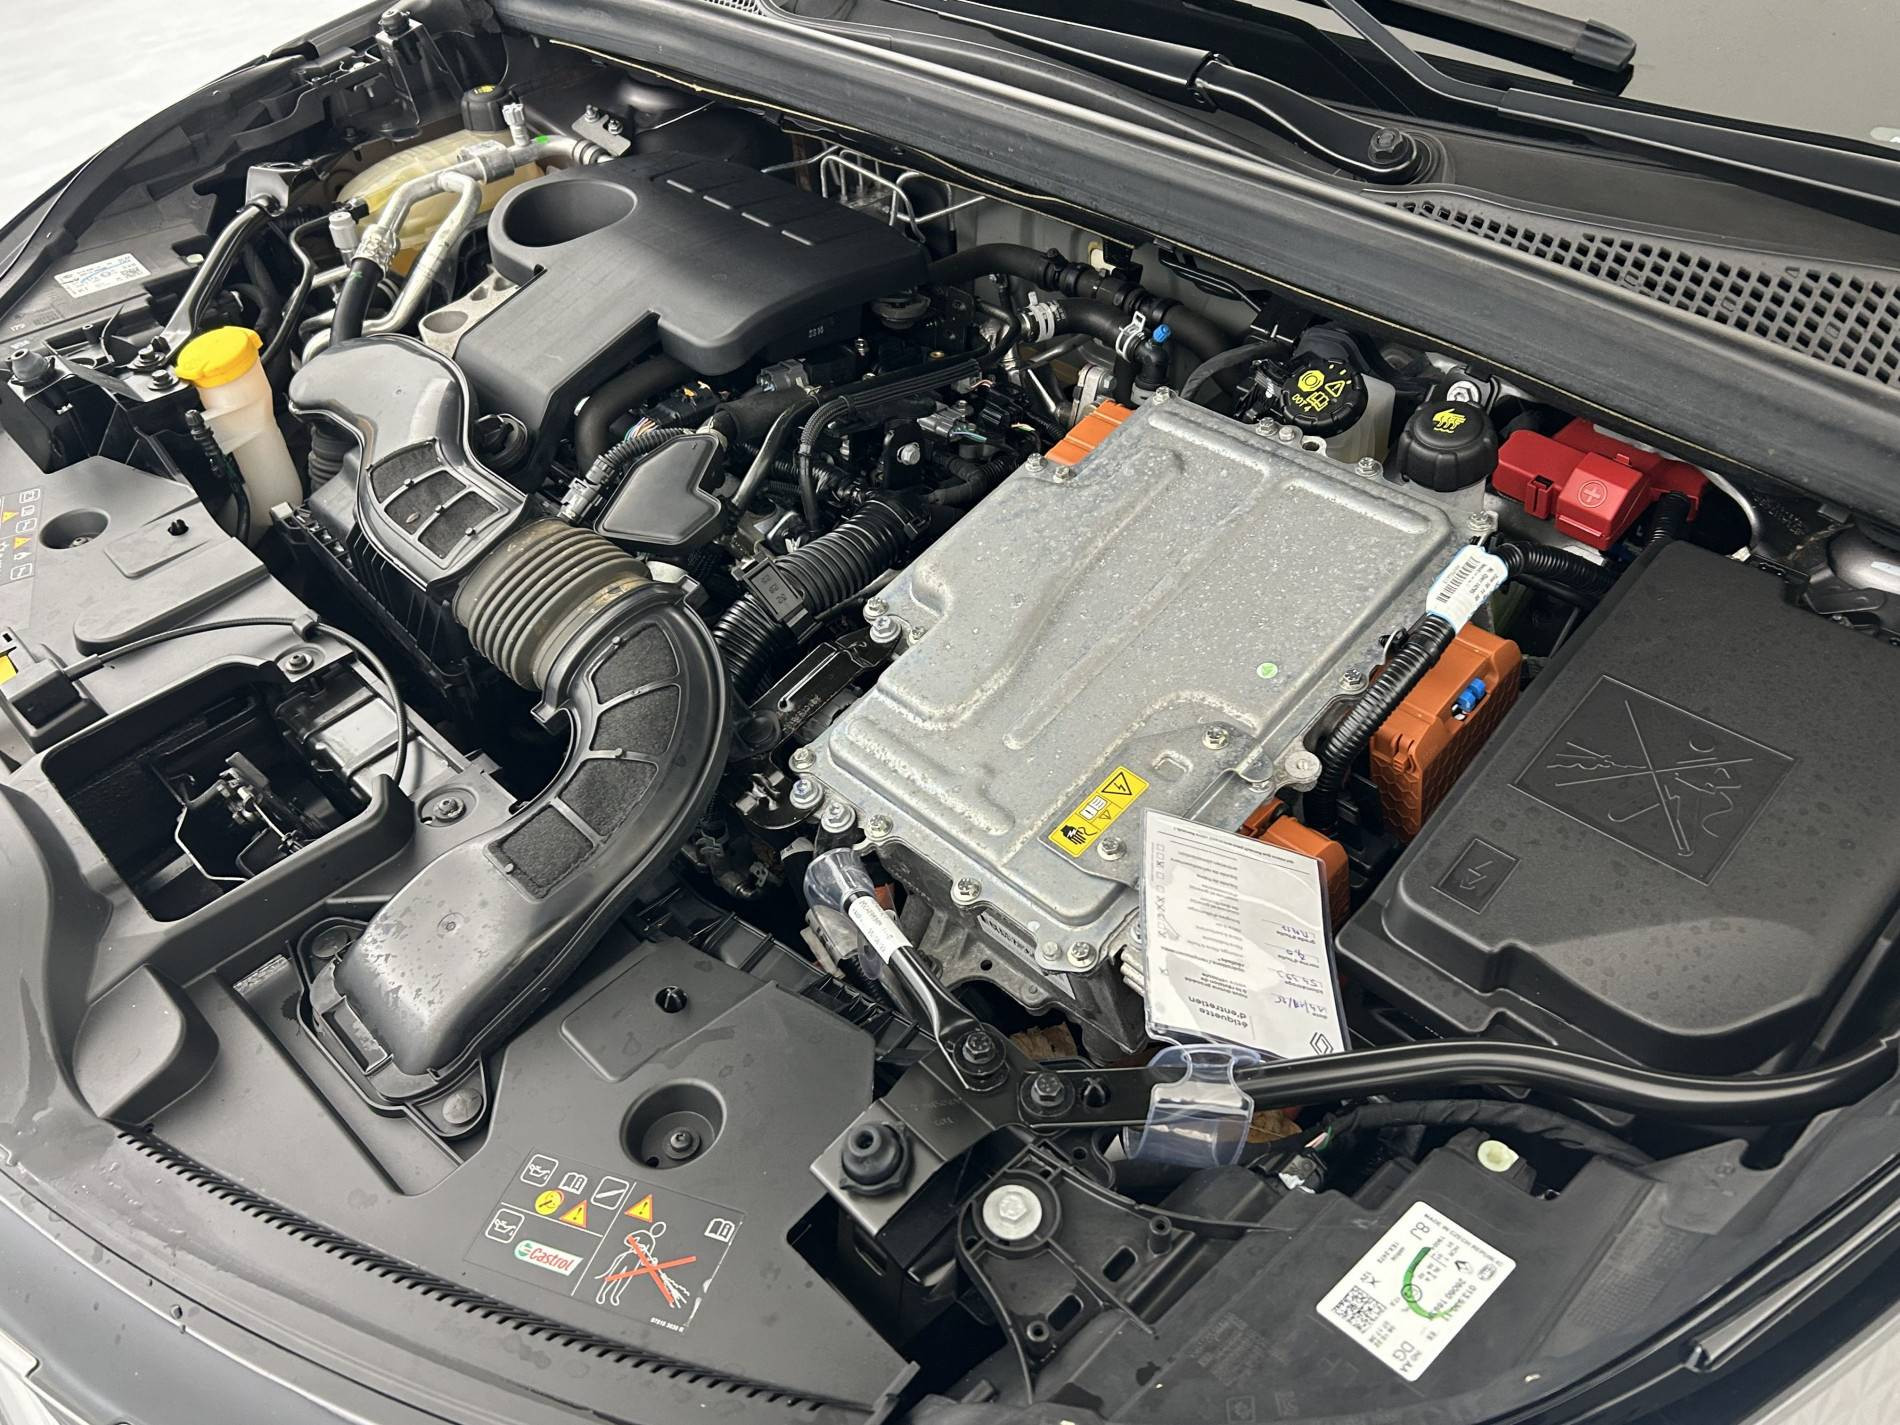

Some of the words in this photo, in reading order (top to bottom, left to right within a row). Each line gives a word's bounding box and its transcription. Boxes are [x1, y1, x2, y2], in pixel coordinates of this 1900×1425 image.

[1292, 394, 1306, 406] DOT
[1188, 995, 1246, 1019] d'entretien
[1198, 1007, 1248, 1028] étiquette
[1410, 1221, 1429, 1239] 8J
[529, 1246, 576, 1270] Castrol
[1392, 1340, 1414, 1362] DG
